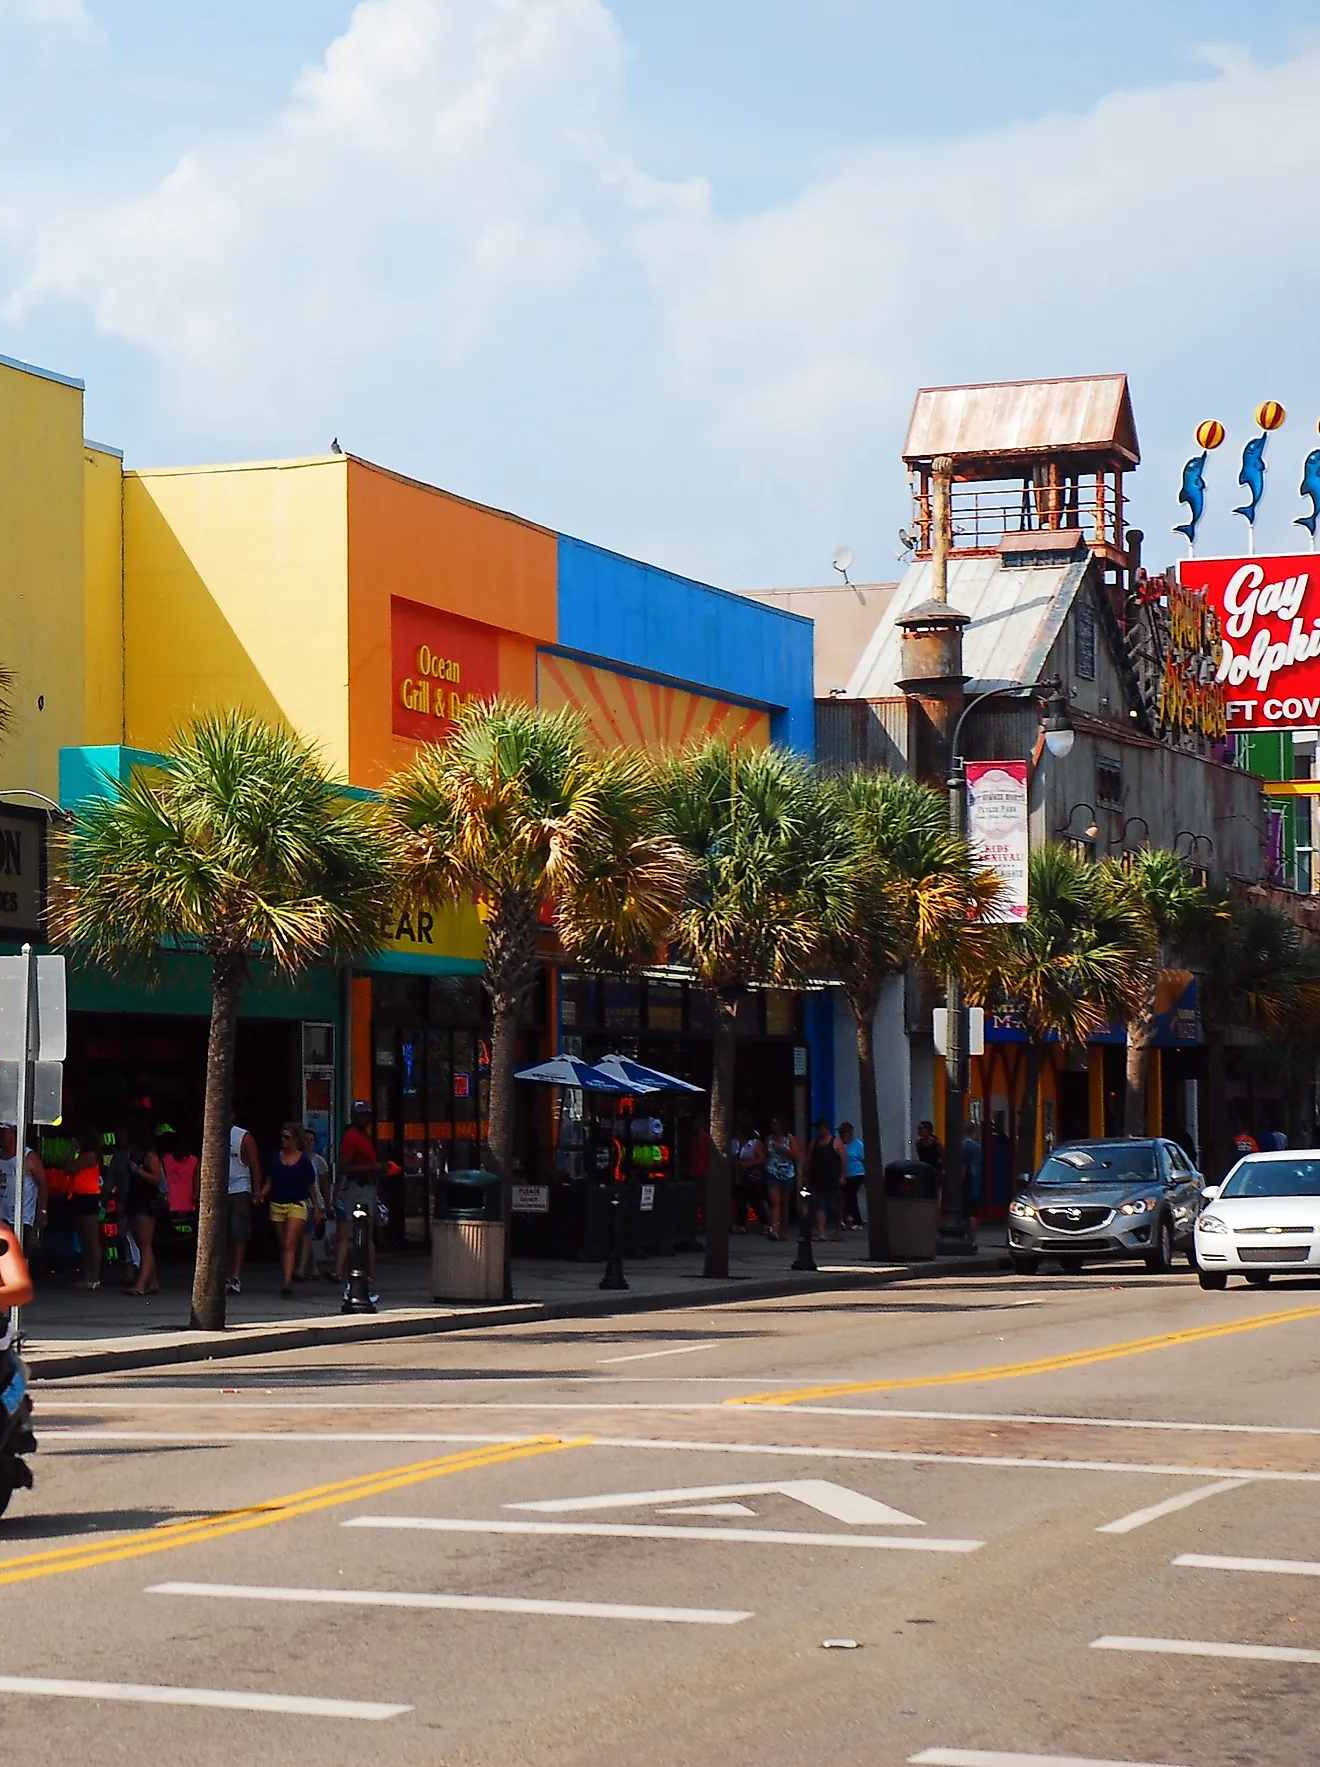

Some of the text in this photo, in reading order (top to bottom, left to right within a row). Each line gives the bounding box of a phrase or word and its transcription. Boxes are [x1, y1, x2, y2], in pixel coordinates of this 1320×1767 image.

[1223, 563, 1309, 638] Gay
[418, 644, 460, 683] Ocean
[401, 678, 430, 714] Grill
[435, 688, 445, 718] &
